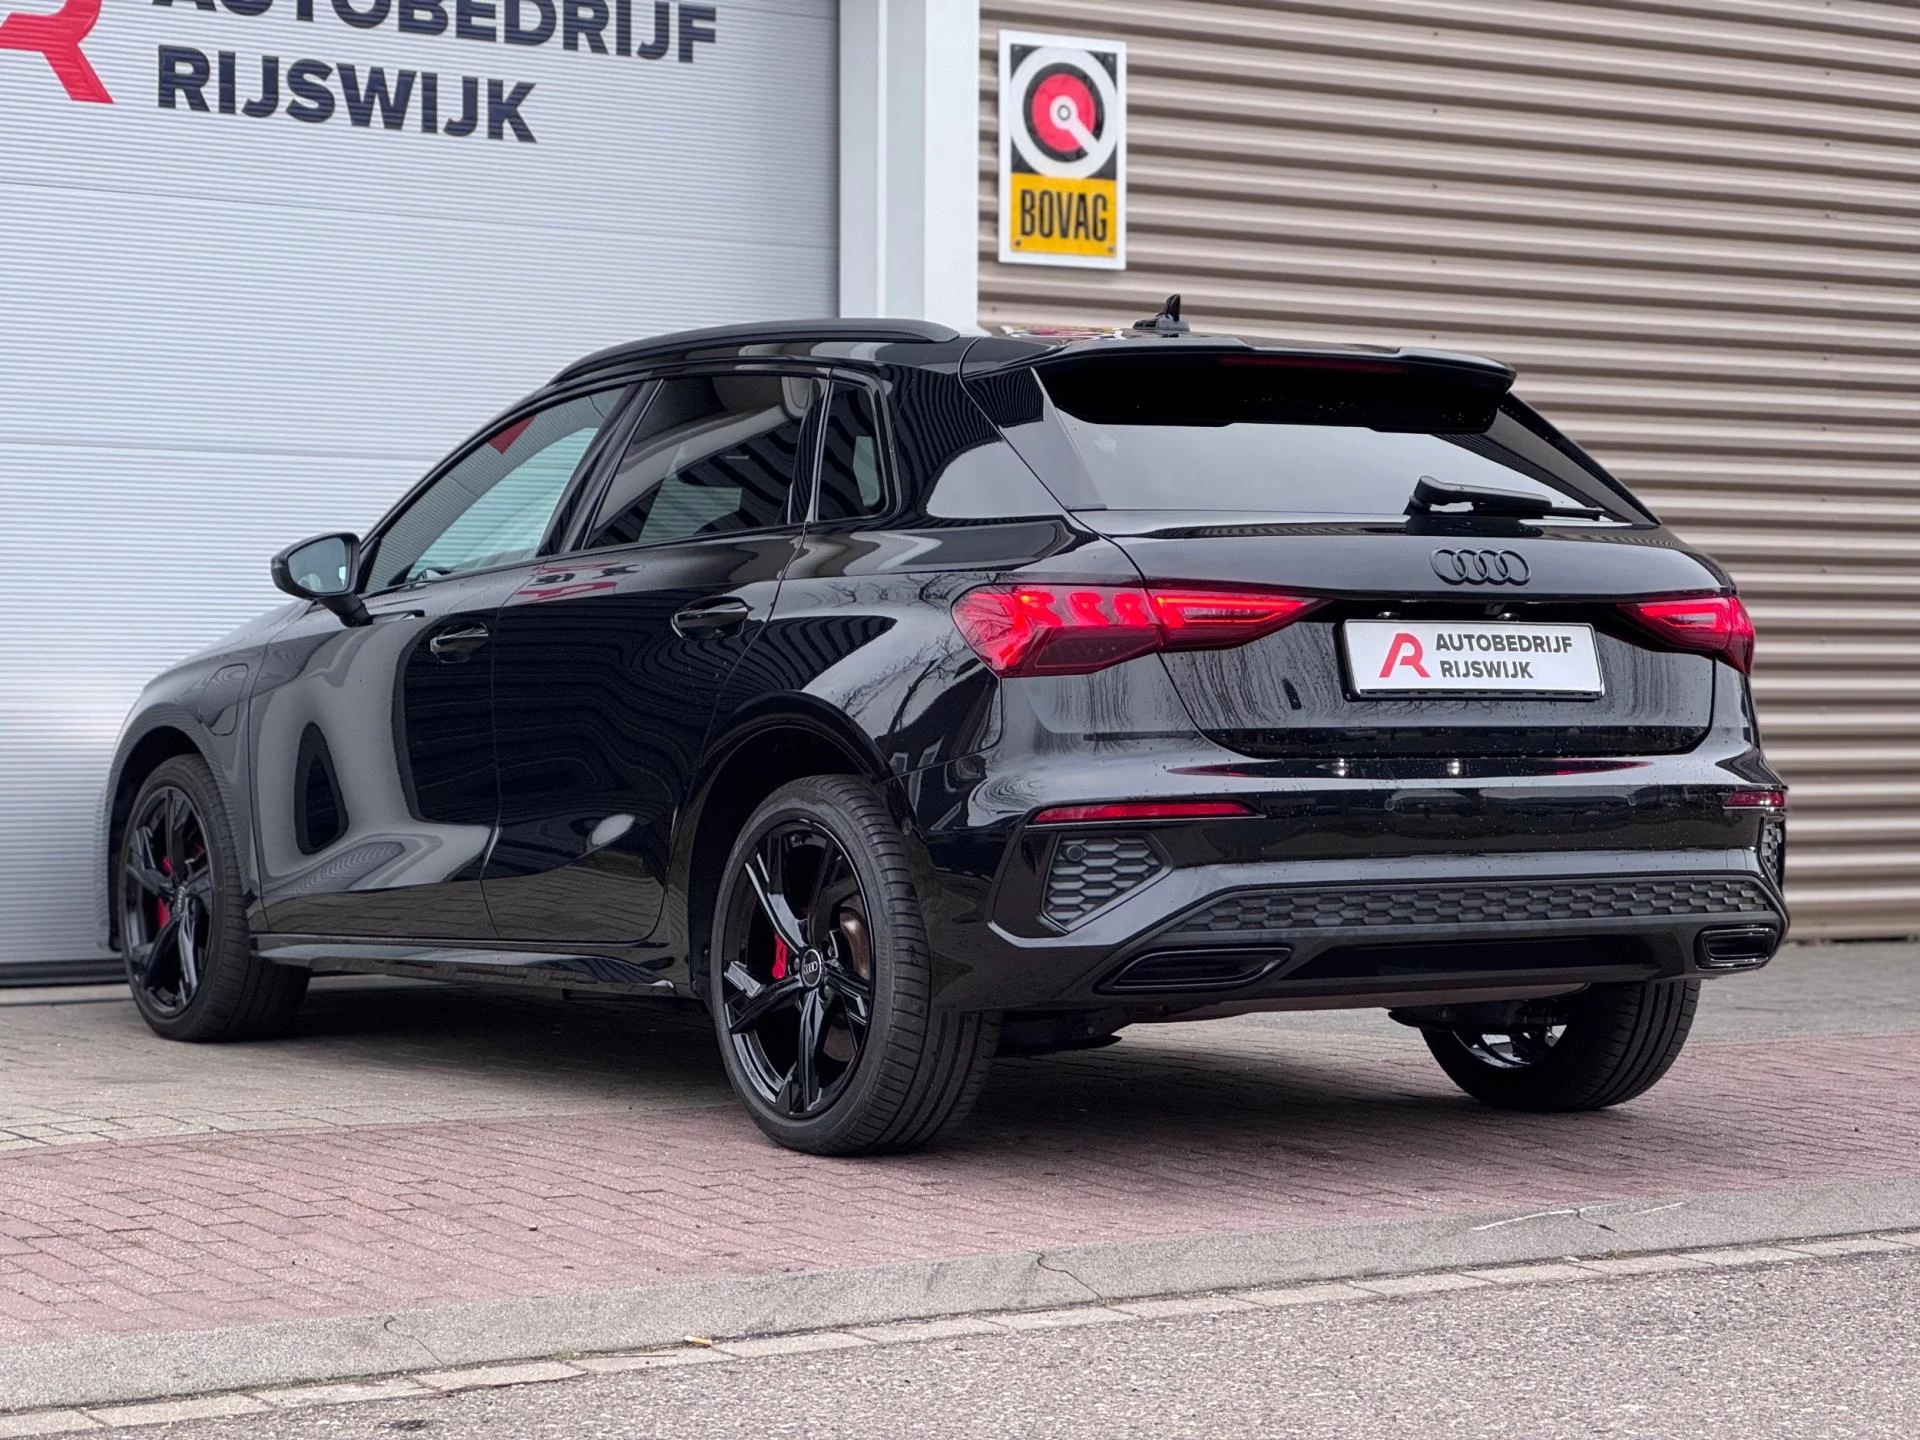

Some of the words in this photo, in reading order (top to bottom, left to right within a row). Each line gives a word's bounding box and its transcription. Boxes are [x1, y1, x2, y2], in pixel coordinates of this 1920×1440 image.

[157, 44, 537, 143] RIJSWIJK
[1020, 189, 1107, 241] BOVAG
[1435, 633, 1572, 653] AUTOBEDRIJF
[1440, 660, 1533, 679] RIJSWIJK
